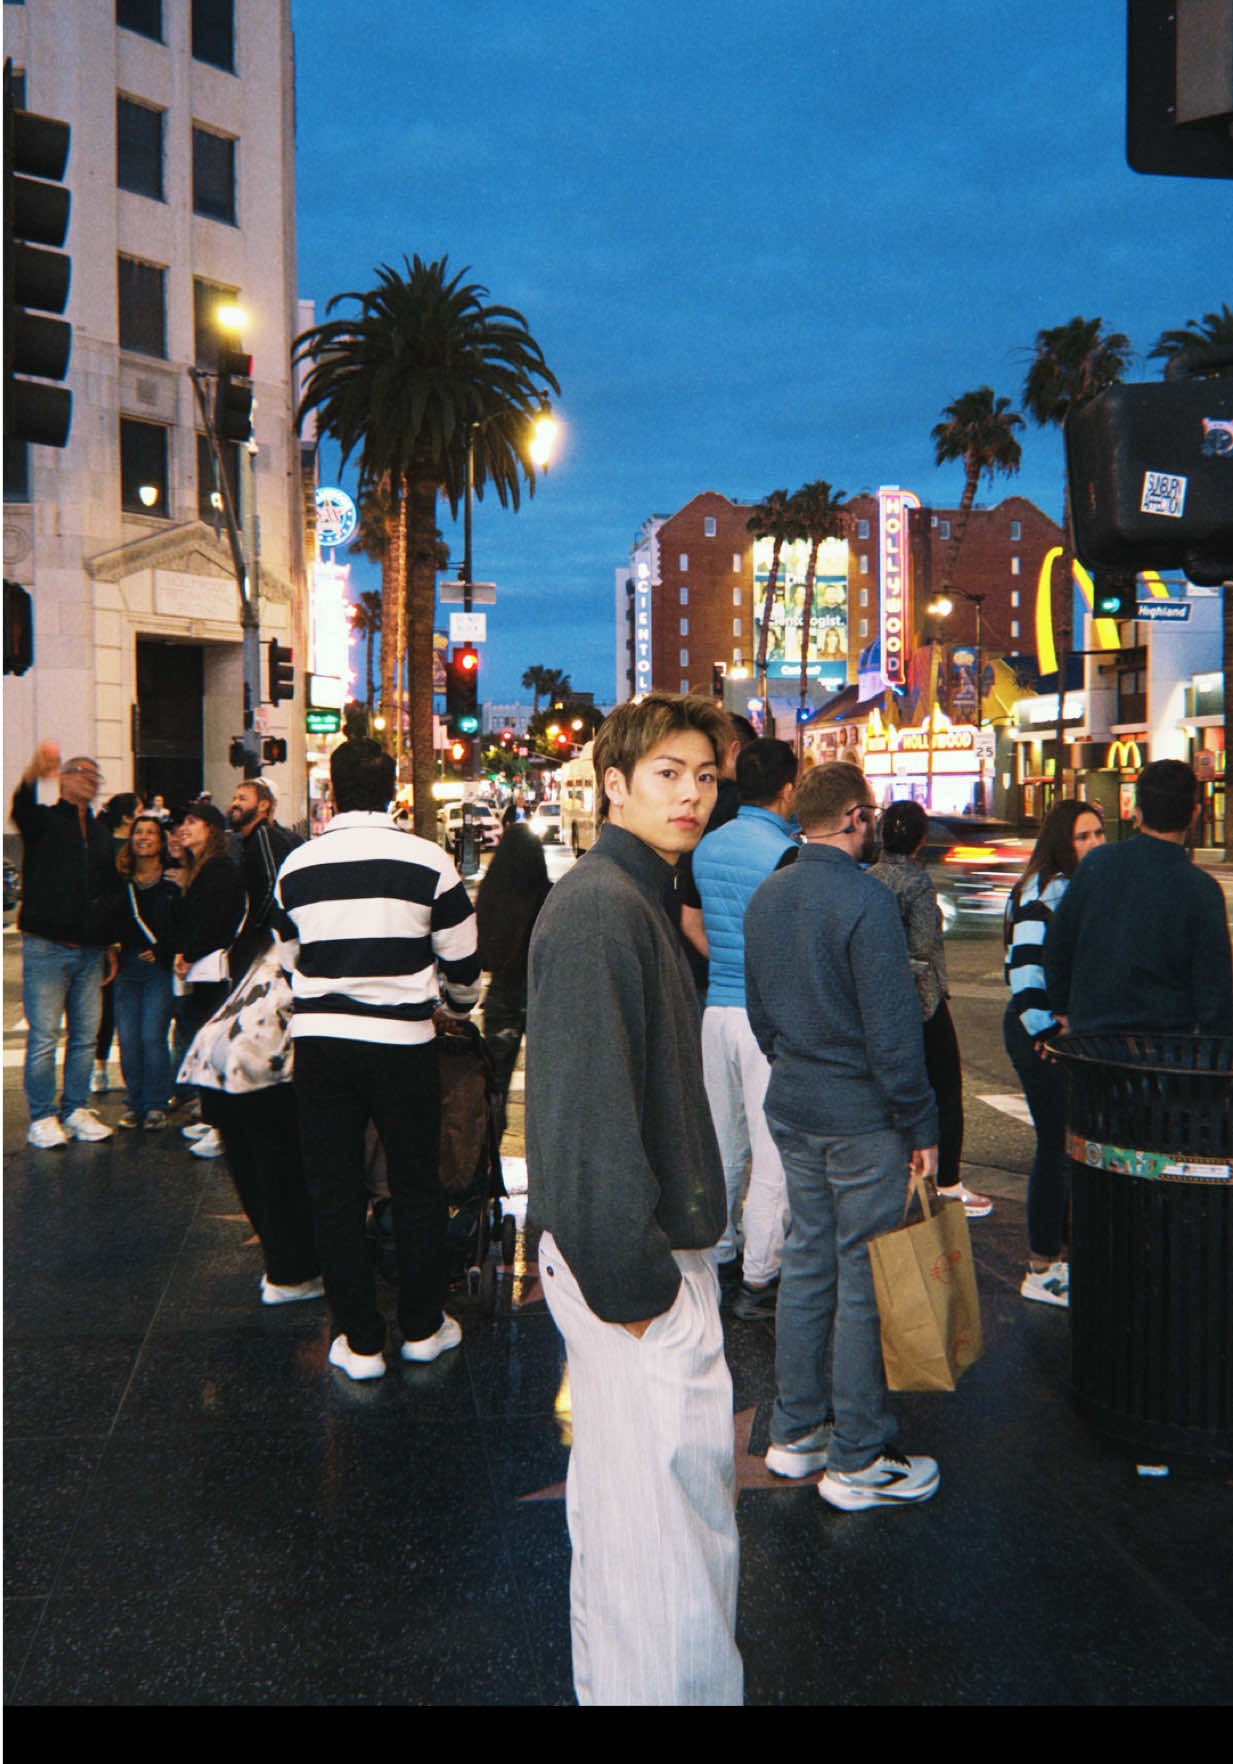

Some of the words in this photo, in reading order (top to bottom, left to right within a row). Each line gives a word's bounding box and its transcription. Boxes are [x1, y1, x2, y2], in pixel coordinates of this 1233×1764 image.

[885, 497, 901, 672] HOLLYWOOD
[1138, 604, 1187, 619] Highland
[976, 746, 993, 758] 25
